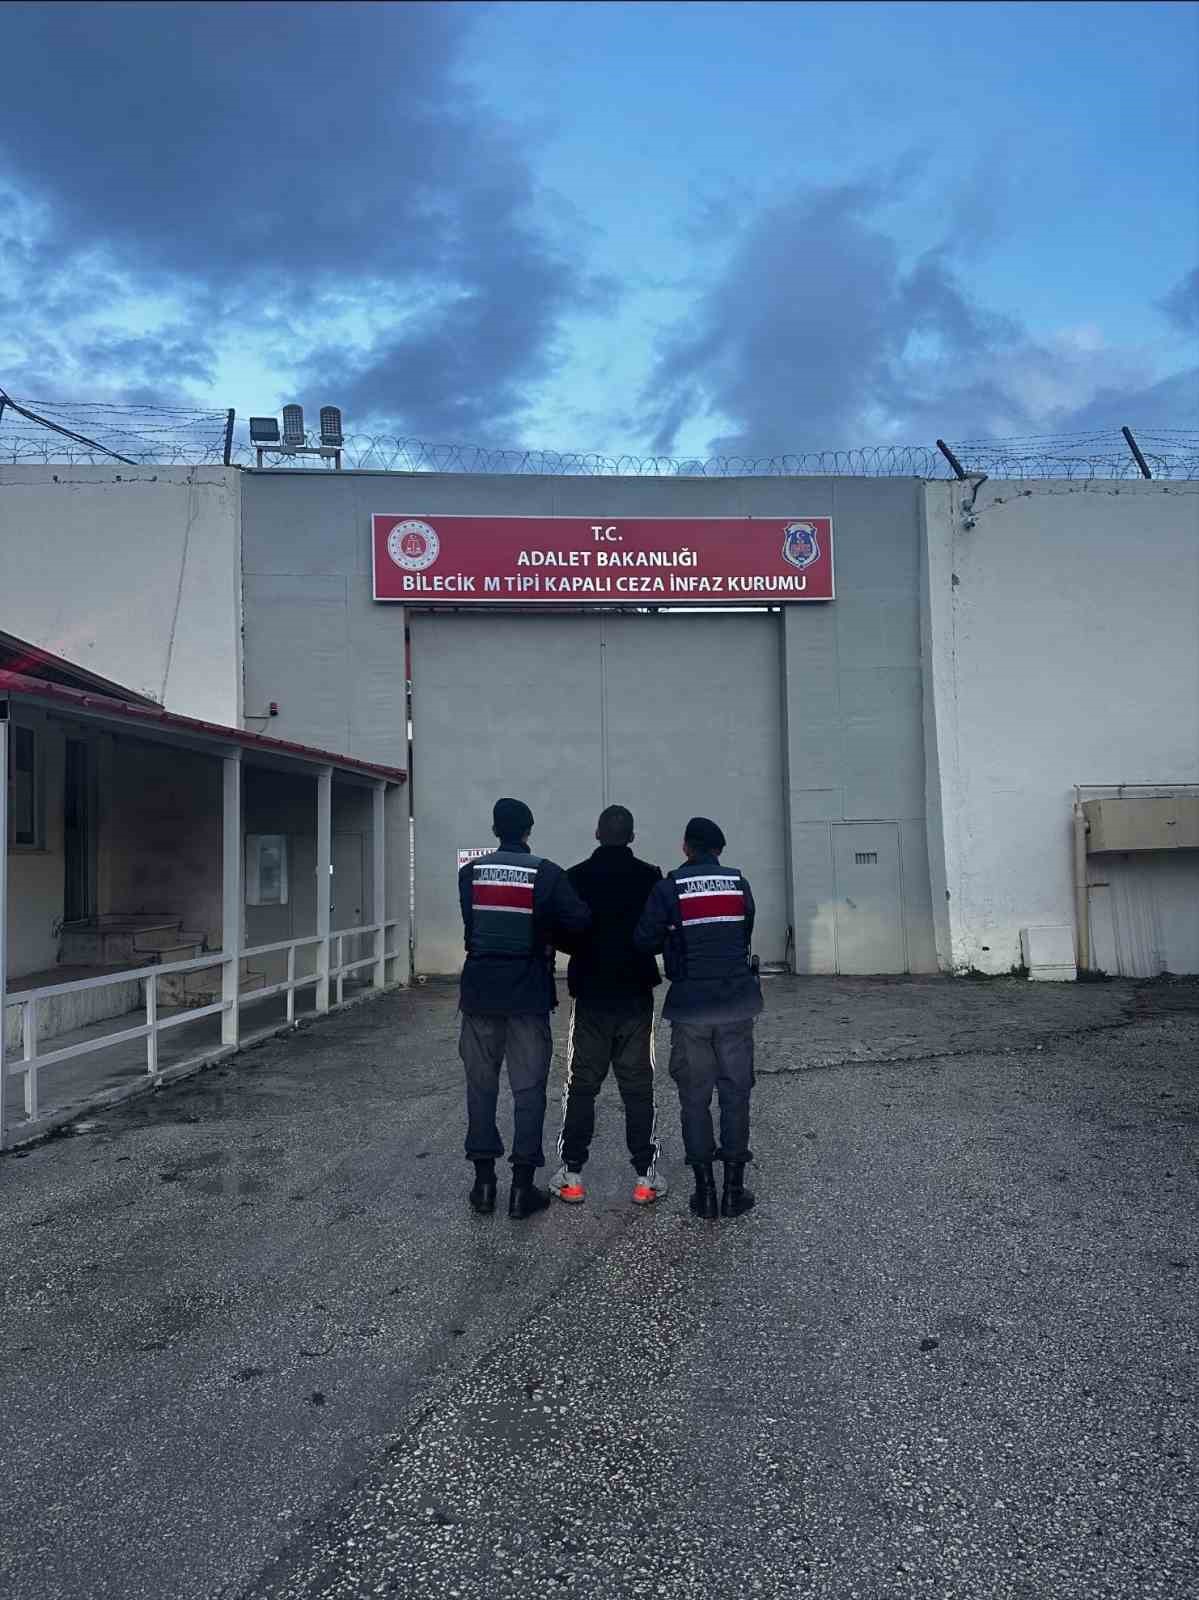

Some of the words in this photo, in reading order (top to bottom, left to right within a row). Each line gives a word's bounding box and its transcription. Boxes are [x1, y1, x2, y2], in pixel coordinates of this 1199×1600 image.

[591, 526, 623, 541] T.C.
[517, 551, 592, 566] ADALET
[597, 547, 698, 567] BAKANLIĞI
[403, 572, 475, 591] BİLECİK
[484, 576, 500, 591] M
[504, 573, 540, 591] TİPİ
[545, 577, 611, 592] KAPALI
[616, 577, 664, 592] CEZA
[670, 573, 723, 592] İNFAZ
[728, 575, 807, 592] KURUMU
[479, 867, 529, 883] JANDARMA
[685, 879, 737, 893] JANDARMA
